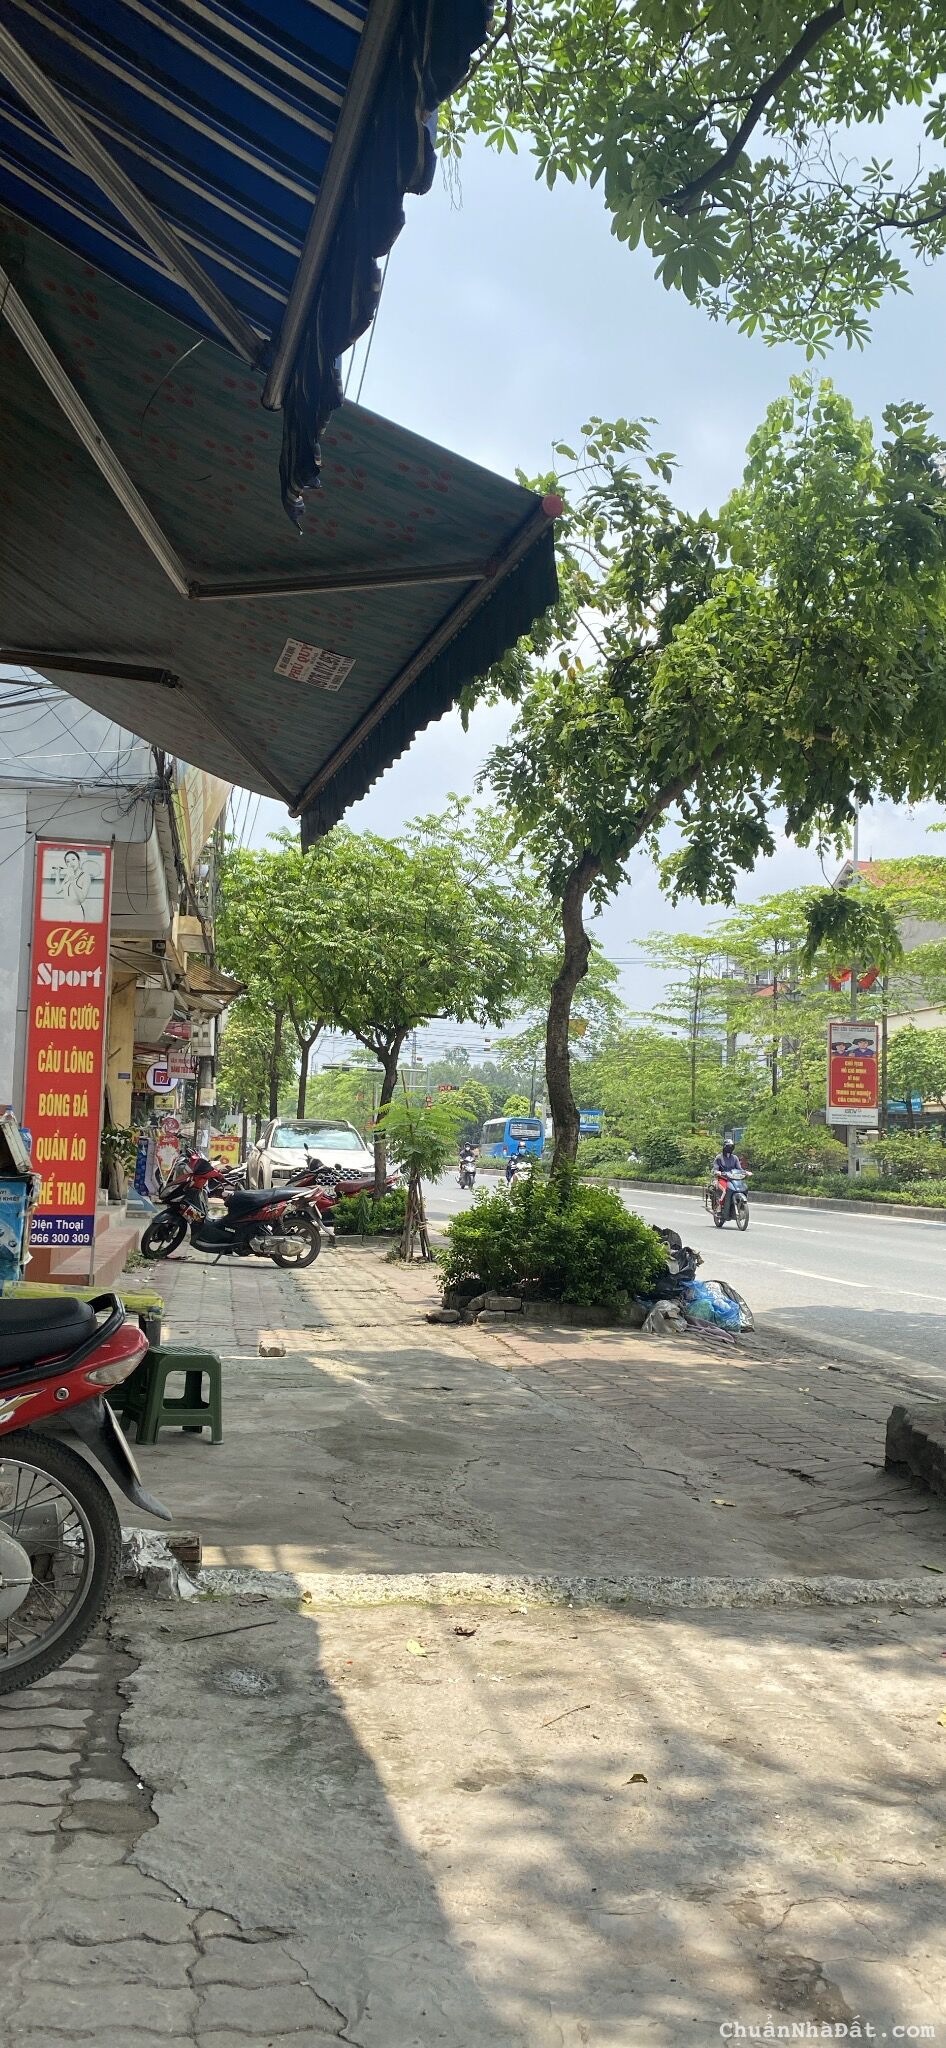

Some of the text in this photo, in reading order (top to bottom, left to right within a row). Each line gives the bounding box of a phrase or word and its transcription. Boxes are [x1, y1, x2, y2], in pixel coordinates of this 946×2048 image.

[46, 927, 96, 957] Kết
[37, 963, 102, 991] Sport
[35, 1002, 100, 1031] CĂNG CƯỚC
[38, 1042, 94, 1074] CẦU LÔNG
[39, 1089, 88, 1117] BÓNG ĐÁ
[36, 1130, 86, 1163] QUẦN ÁO
[39, 1172, 85, 1206] HỂ THAO
[30, 1233, 89, 1243] 966 300 309
[31, 1220, 84, 1231] Điện Thoại
